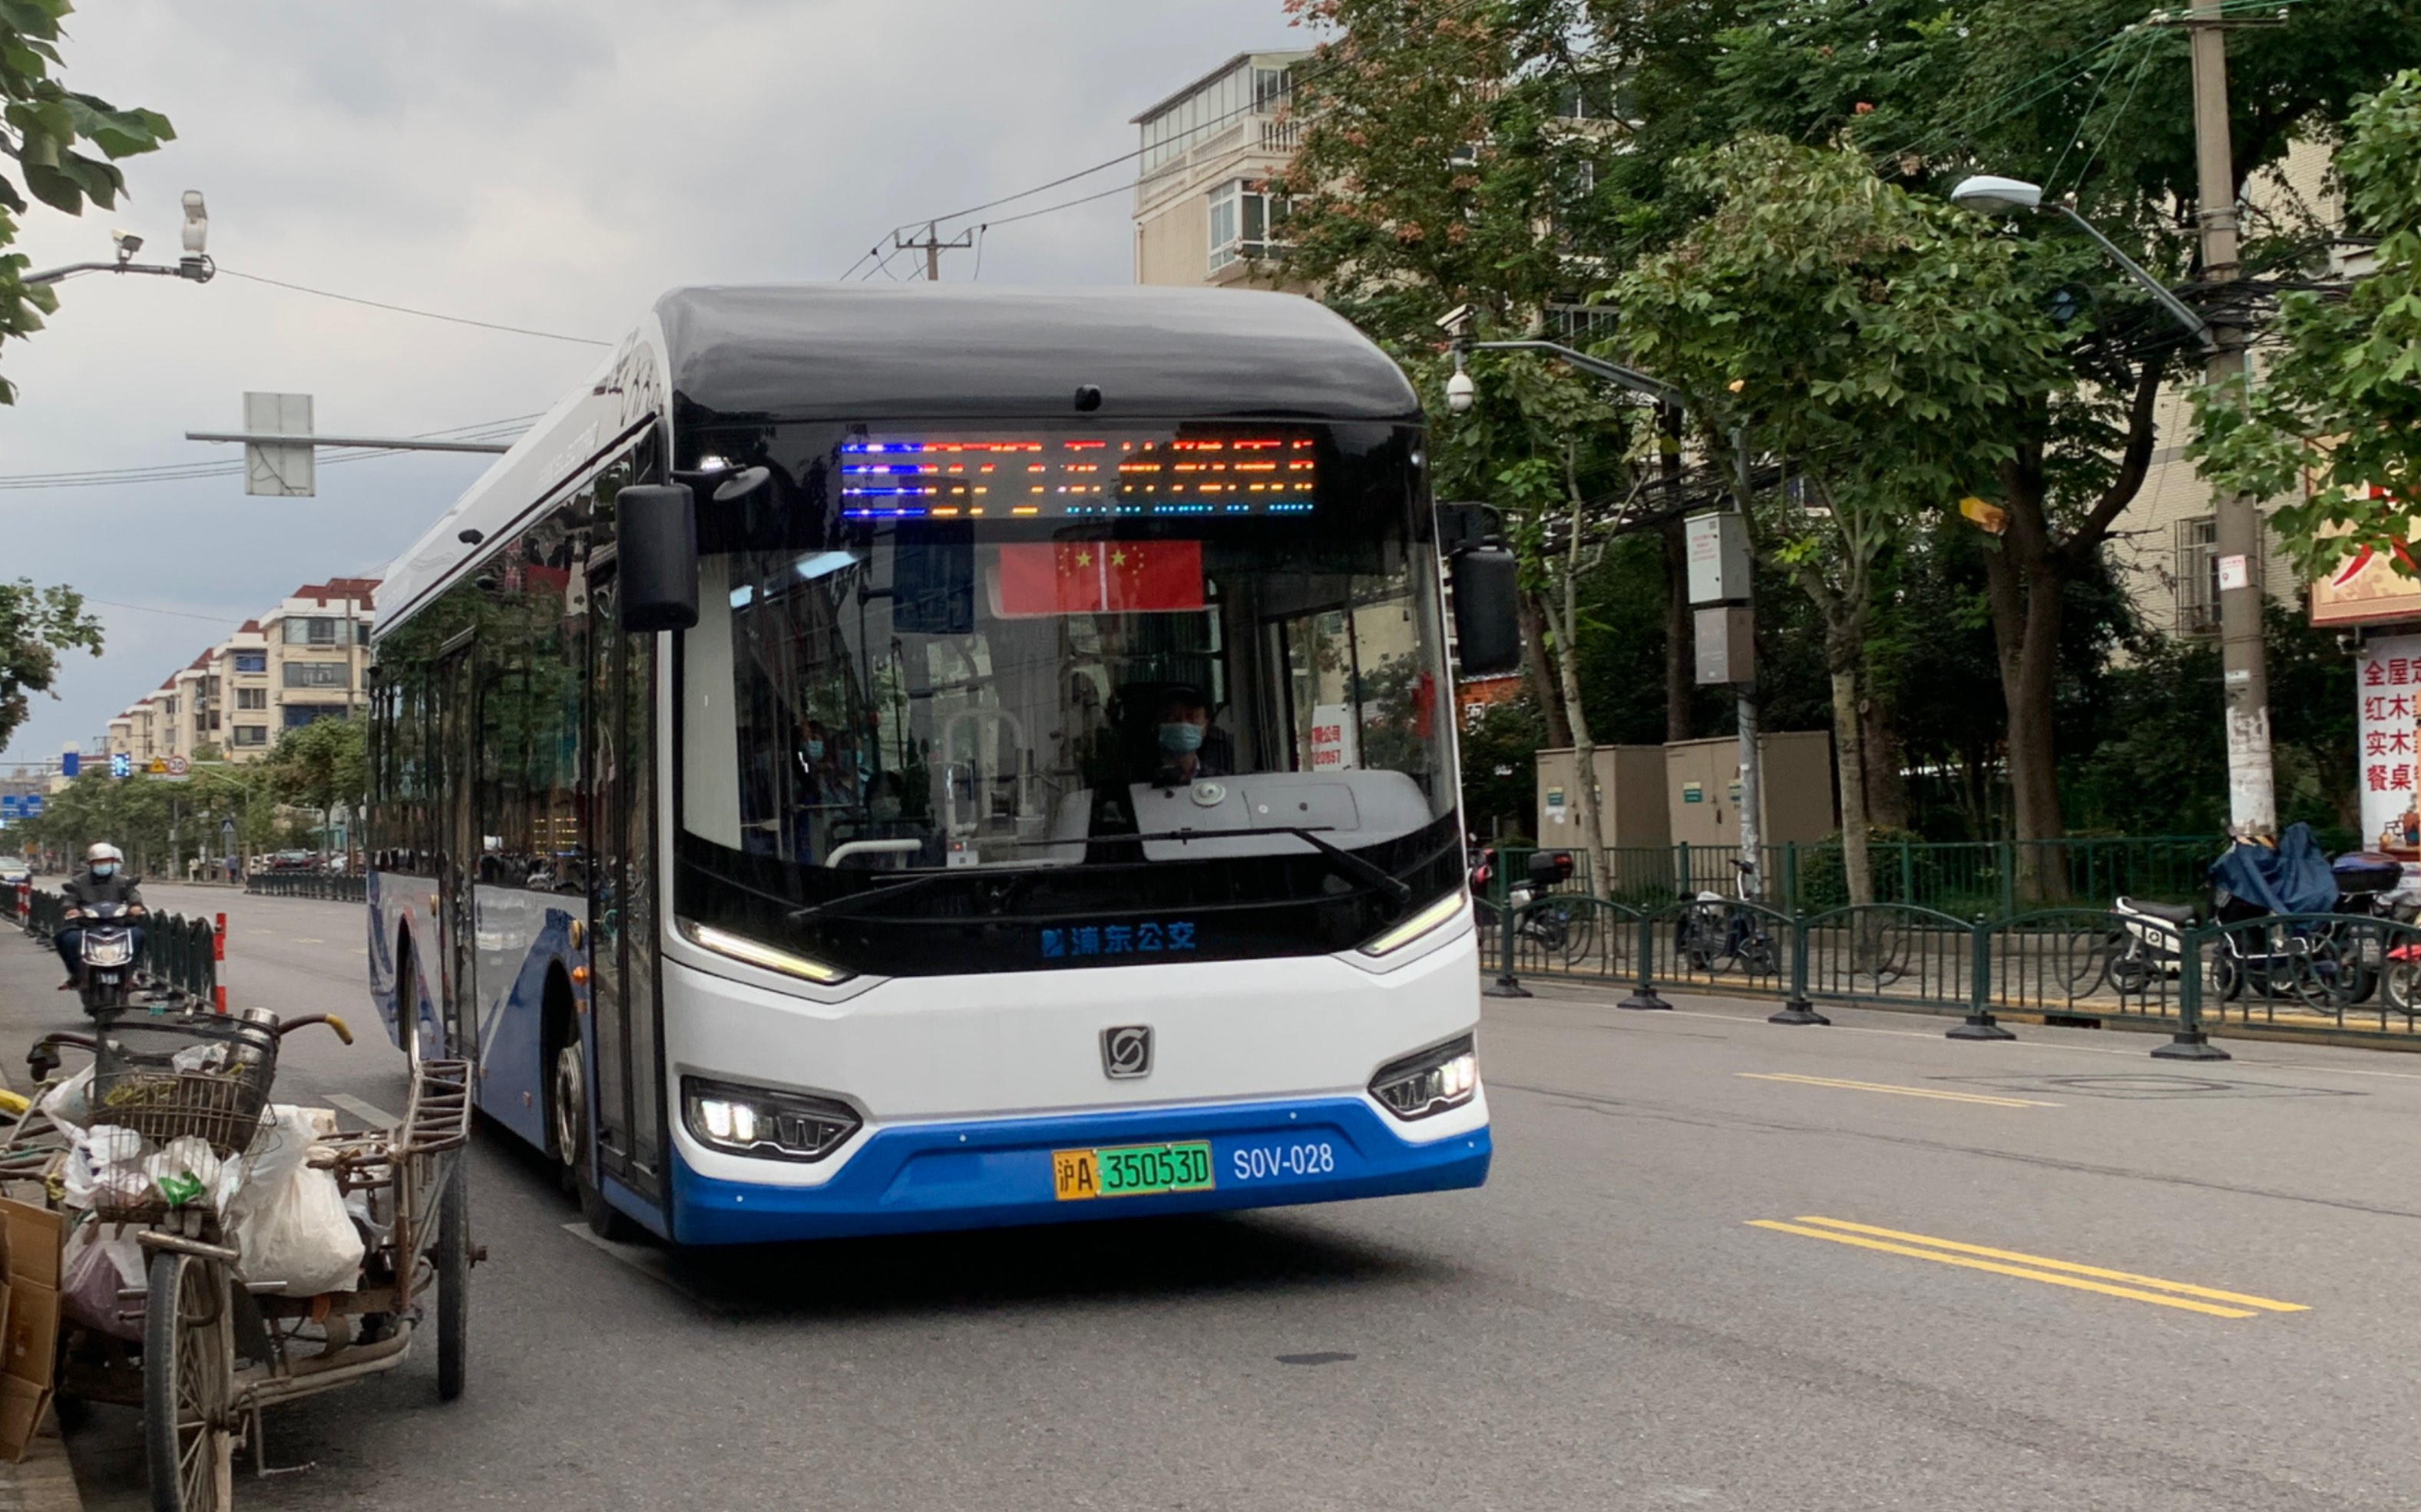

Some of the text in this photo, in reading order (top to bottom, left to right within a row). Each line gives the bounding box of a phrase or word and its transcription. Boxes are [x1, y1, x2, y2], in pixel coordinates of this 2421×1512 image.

[2366, 729, 2418, 757] 实木
[2367, 764, 2418, 792] 餐桌
[1072, 921, 1196, 955] 浦东公交
[1106, 1149, 1209, 1189] 35053D
